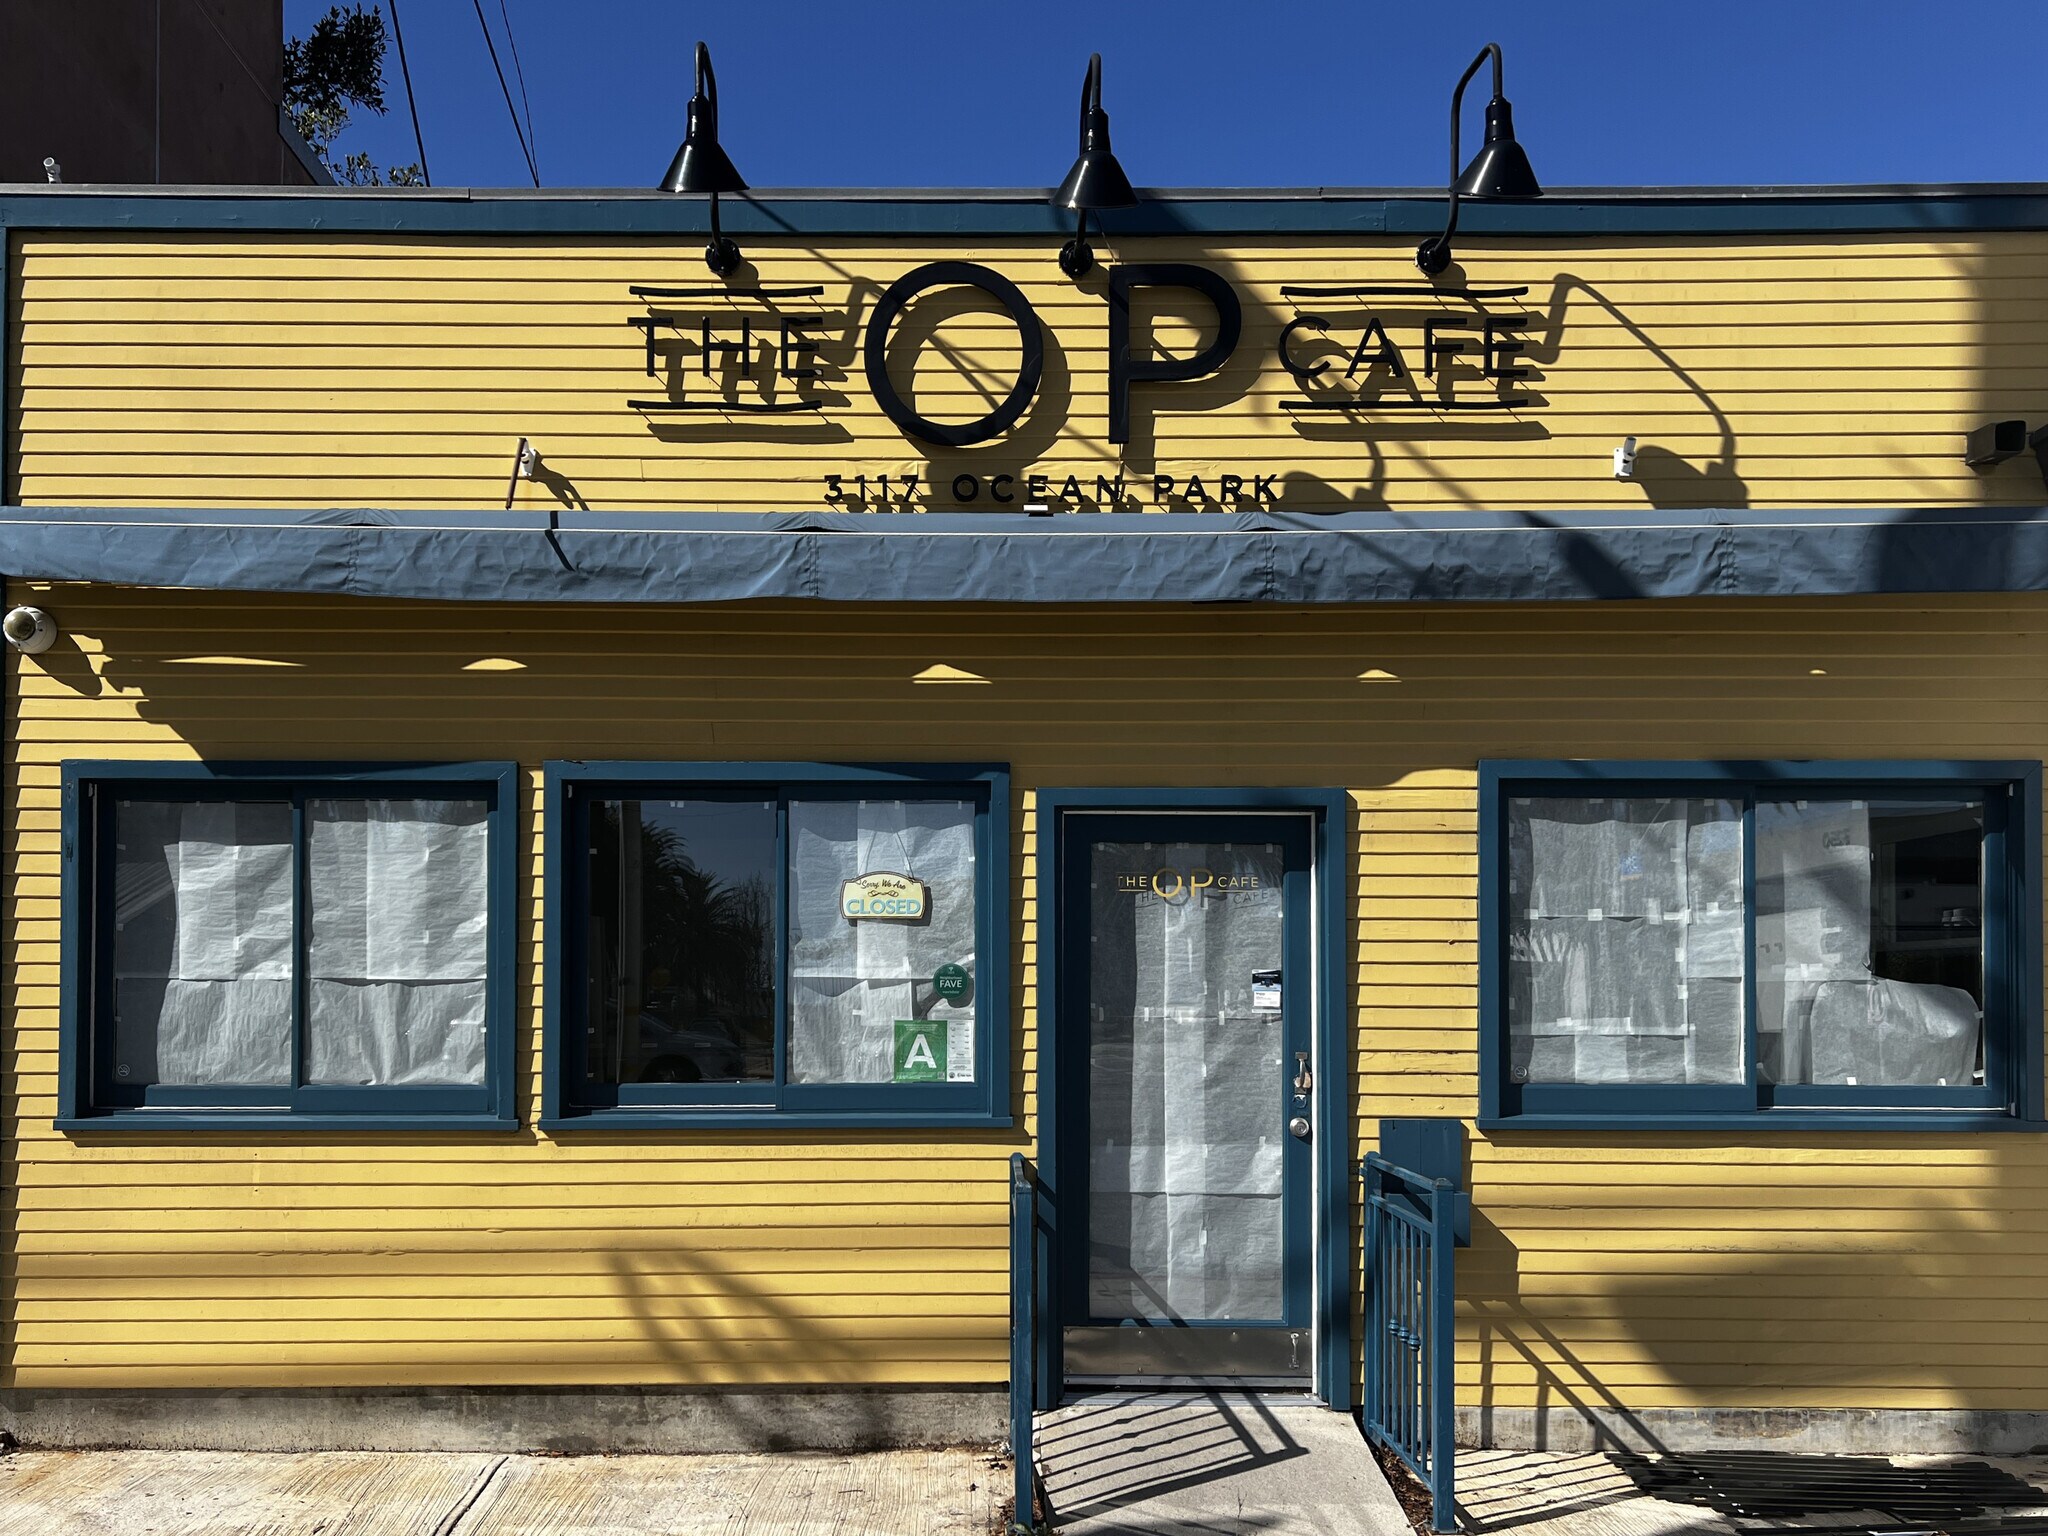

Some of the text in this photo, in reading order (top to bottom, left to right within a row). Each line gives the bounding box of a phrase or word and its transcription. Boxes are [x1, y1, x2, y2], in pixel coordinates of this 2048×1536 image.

[627, 316, 824, 378] THE
[1278, 316, 1528, 378] CAFE
[823, 474, 1279, 503] 3117 OCEAN PARK
[1116, 876, 1148, 888] THE
[1217, 876, 1259, 888] CAFE
[845, 898, 921, 915] CLOSED
[939, 979, 963, 988] FAVE
[903, 1033, 938, 1069] A
